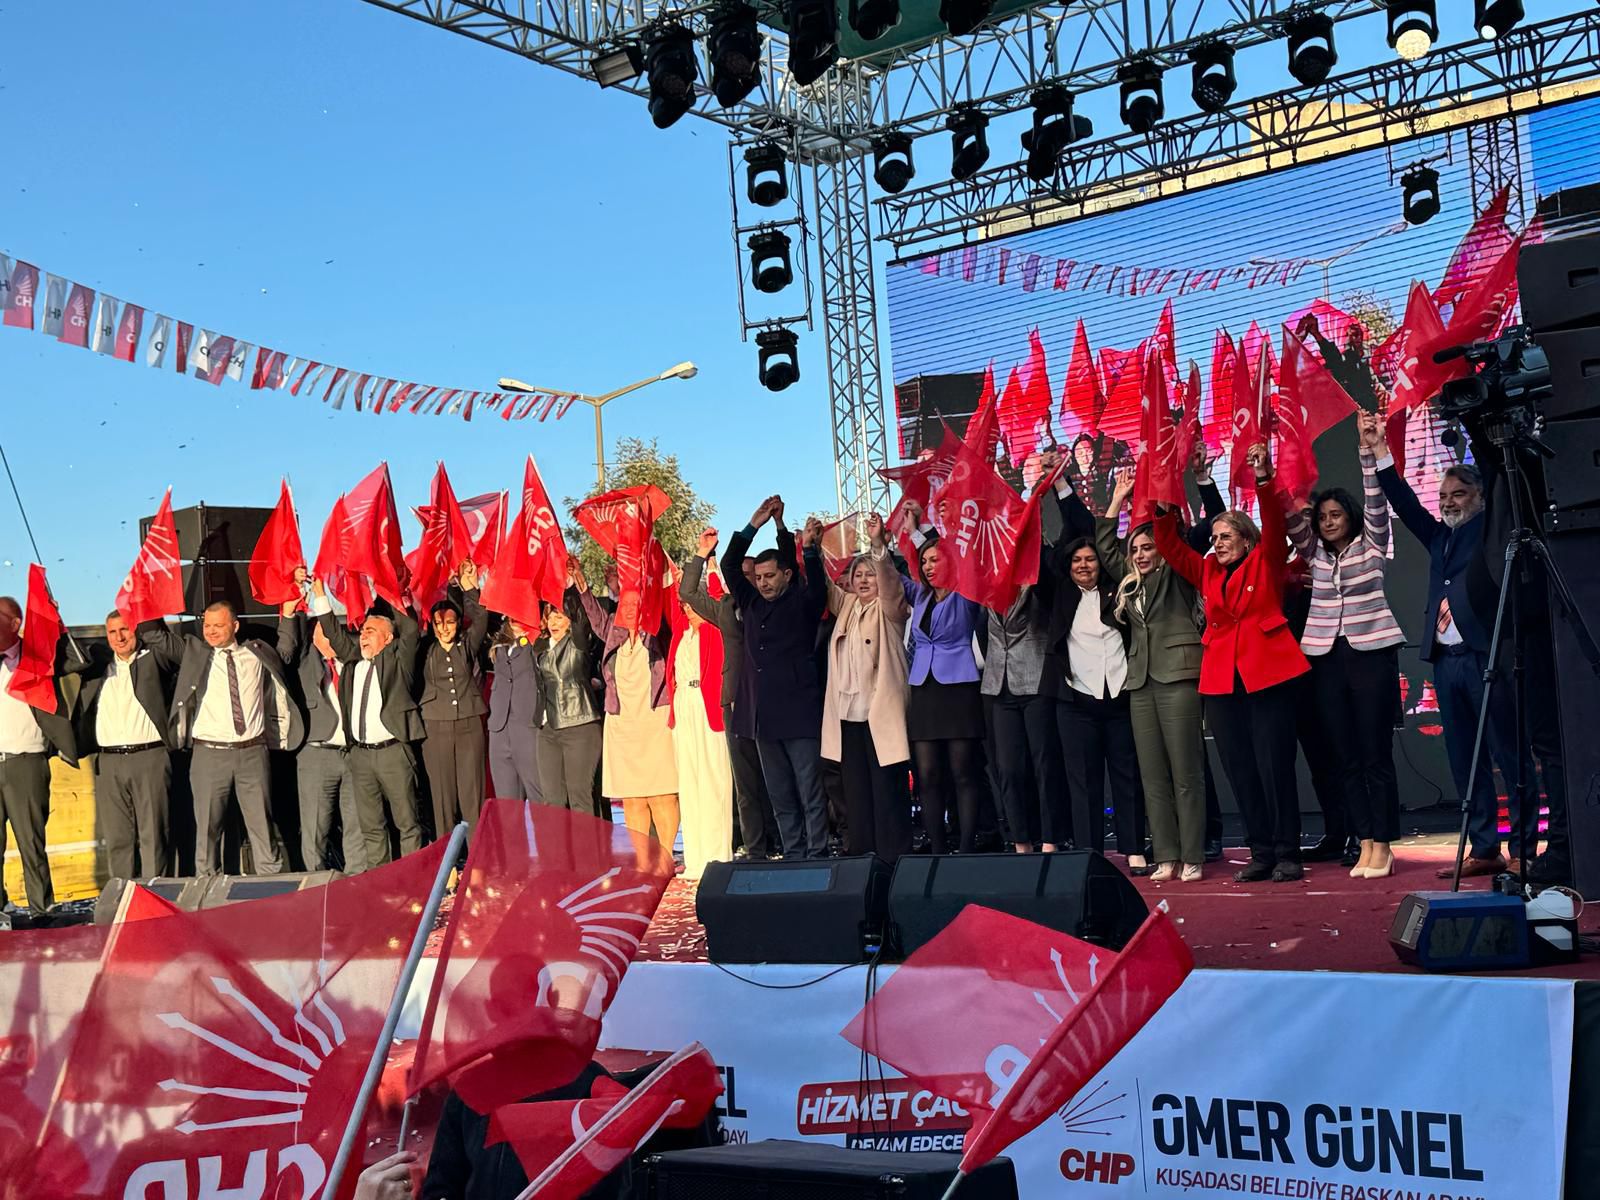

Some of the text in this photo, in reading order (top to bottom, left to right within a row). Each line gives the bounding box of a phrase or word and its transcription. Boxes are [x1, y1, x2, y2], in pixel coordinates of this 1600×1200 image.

[15, 295, 33, 308] CH
[70, 315, 88, 328] CH
[528, 506, 555, 556] CHP
[800, 1088, 909, 1125] HİZMET
[721, 1127, 748, 1145] DAYI
[910, 1134, 967, 1152] EDECE
[1304, 1103, 1484, 1182] GÜNEL
[1060, 1148, 1136, 1185] CHP
[1156, 1168, 1247, 1192] KUŞADASI
[1251, 1175, 1338, 1200] BELEDİYE
